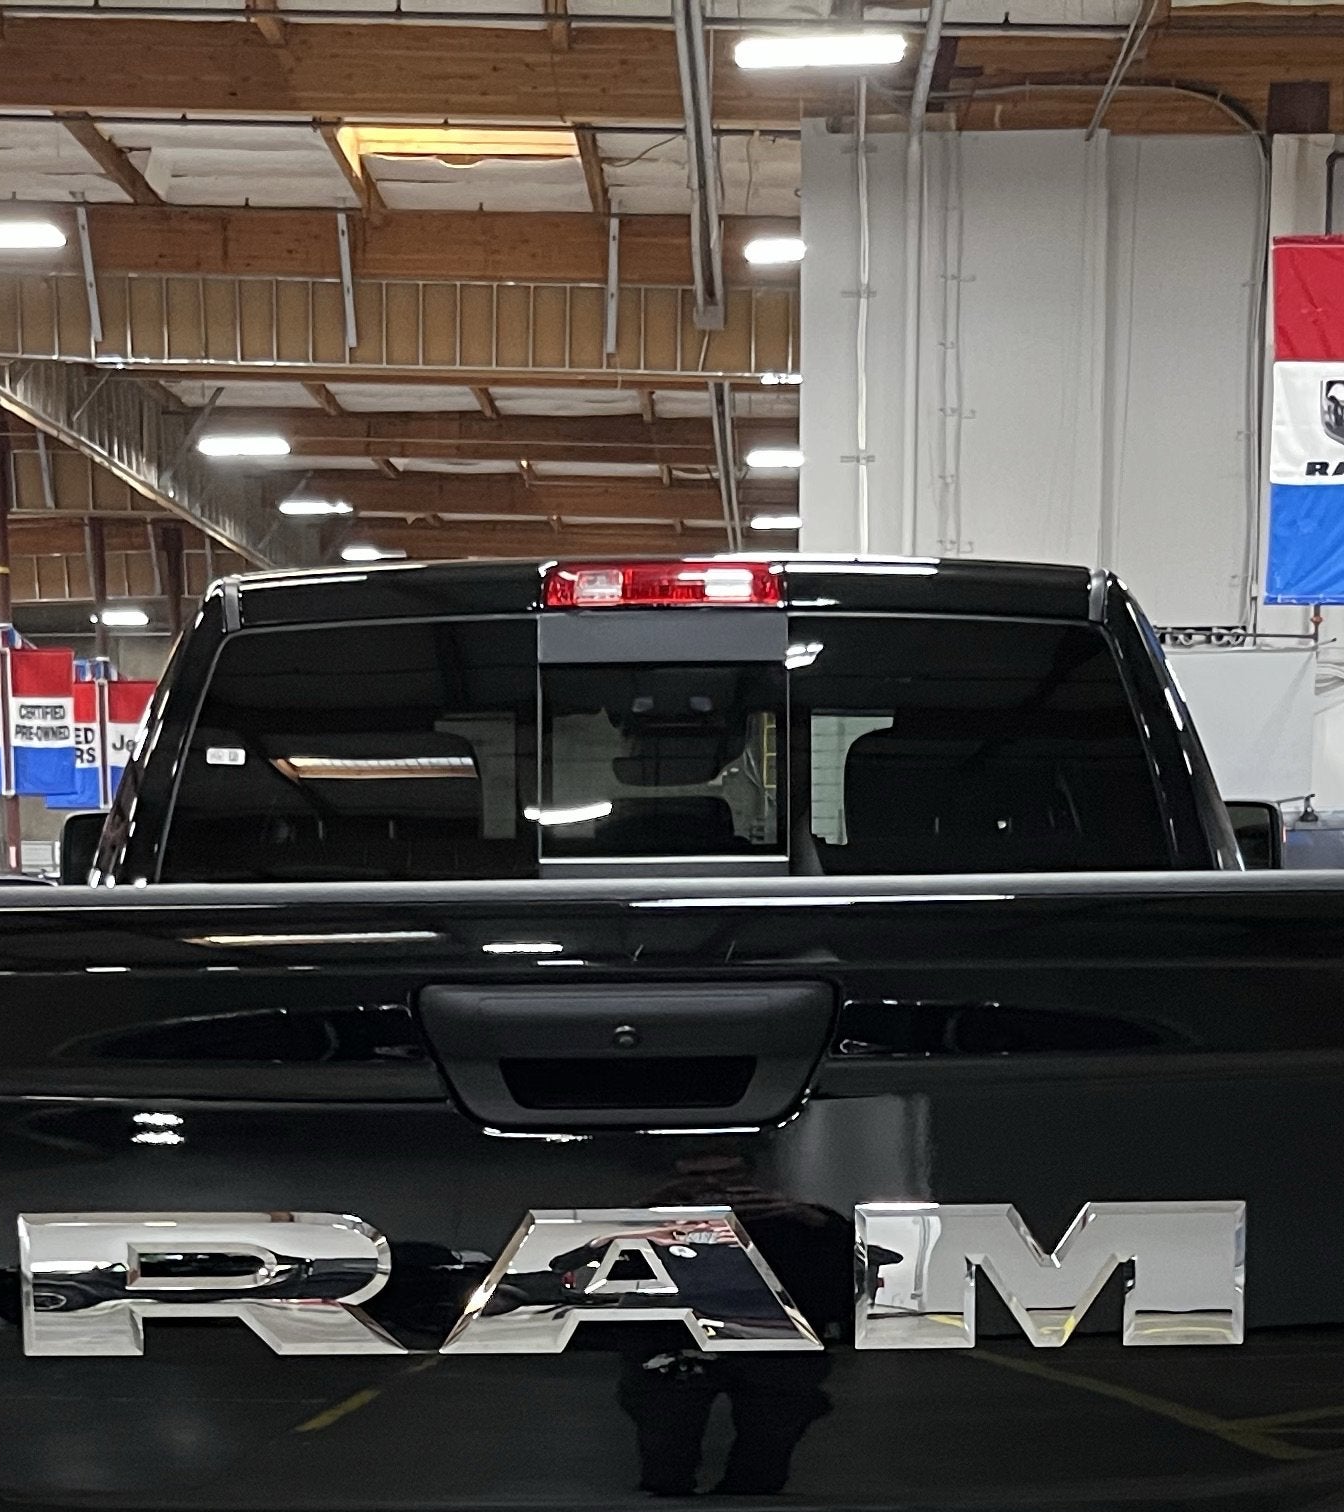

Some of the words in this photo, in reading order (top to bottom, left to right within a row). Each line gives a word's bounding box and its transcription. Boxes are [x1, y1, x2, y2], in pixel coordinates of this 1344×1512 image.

[19, 705, 65, 720] CERTIFIED
[15, 724, 70, 741] PRE-OWNED
[16, 1201, 1247, 1356] RAM
